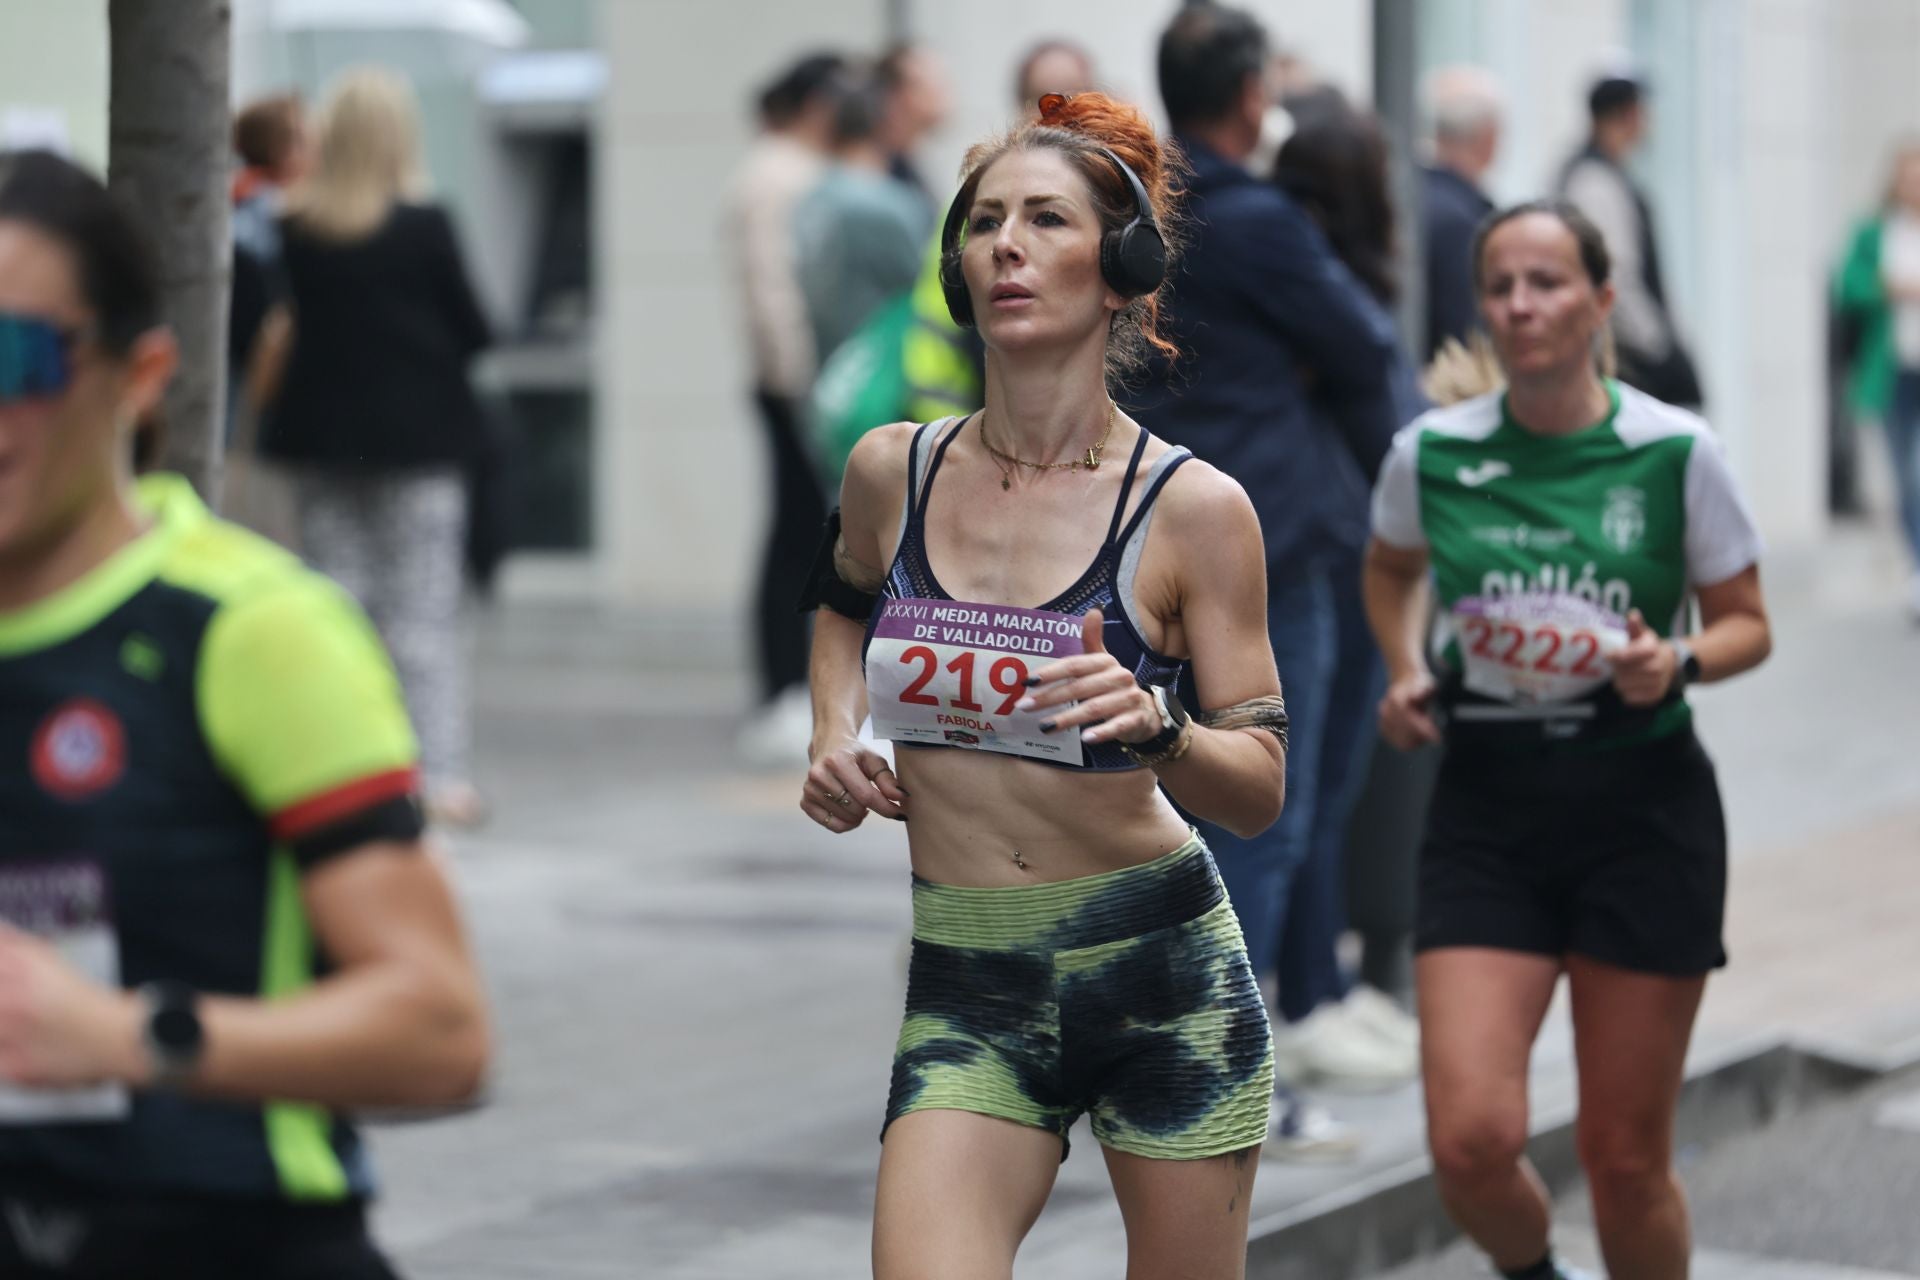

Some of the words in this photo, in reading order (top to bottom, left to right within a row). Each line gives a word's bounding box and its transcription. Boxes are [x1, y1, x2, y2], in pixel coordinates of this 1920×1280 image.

[884, 604, 928, 620] XXXVI
[932, 607, 989, 626] MEDIA
[993, 613, 1084, 639] MARATÓN
[914, 624, 938, 640] DE
[942, 627, 1055, 653] VALLADOLID
[1466, 619, 1599, 676] 2222
[899, 645, 1029, 716] 219
[937, 714, 995, 731] FABIOLA
